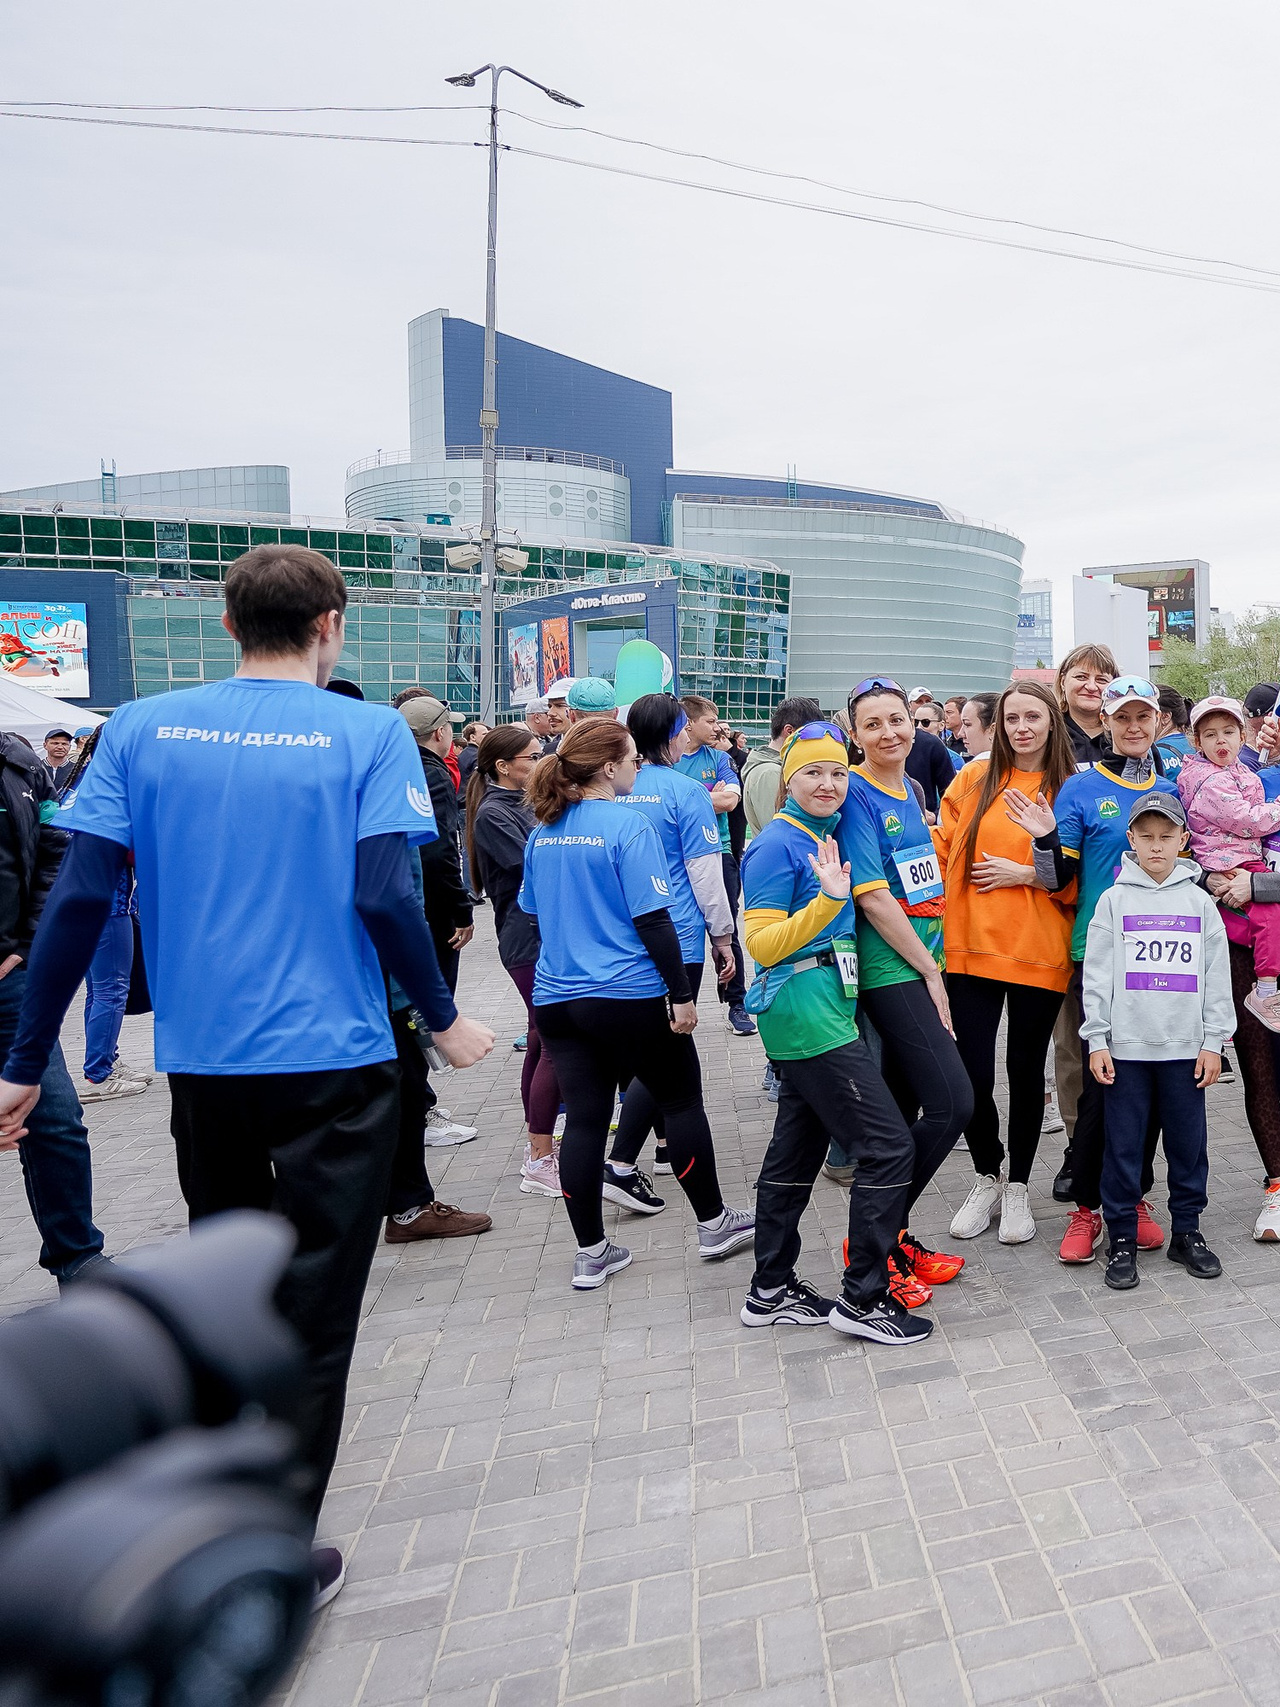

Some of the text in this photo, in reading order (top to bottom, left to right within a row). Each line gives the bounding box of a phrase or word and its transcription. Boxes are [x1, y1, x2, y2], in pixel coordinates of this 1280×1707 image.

[156, 726, 332, 748] БЕРИ И ДЕЛАЙ!
[626, 794, 662, 804] ДЕЛАЙ!
[563, 835, 605, 847] ДЕЛАЙ!
[909, 860, 934, 885] 800
[1135, 940, 1192, 963] 2078
